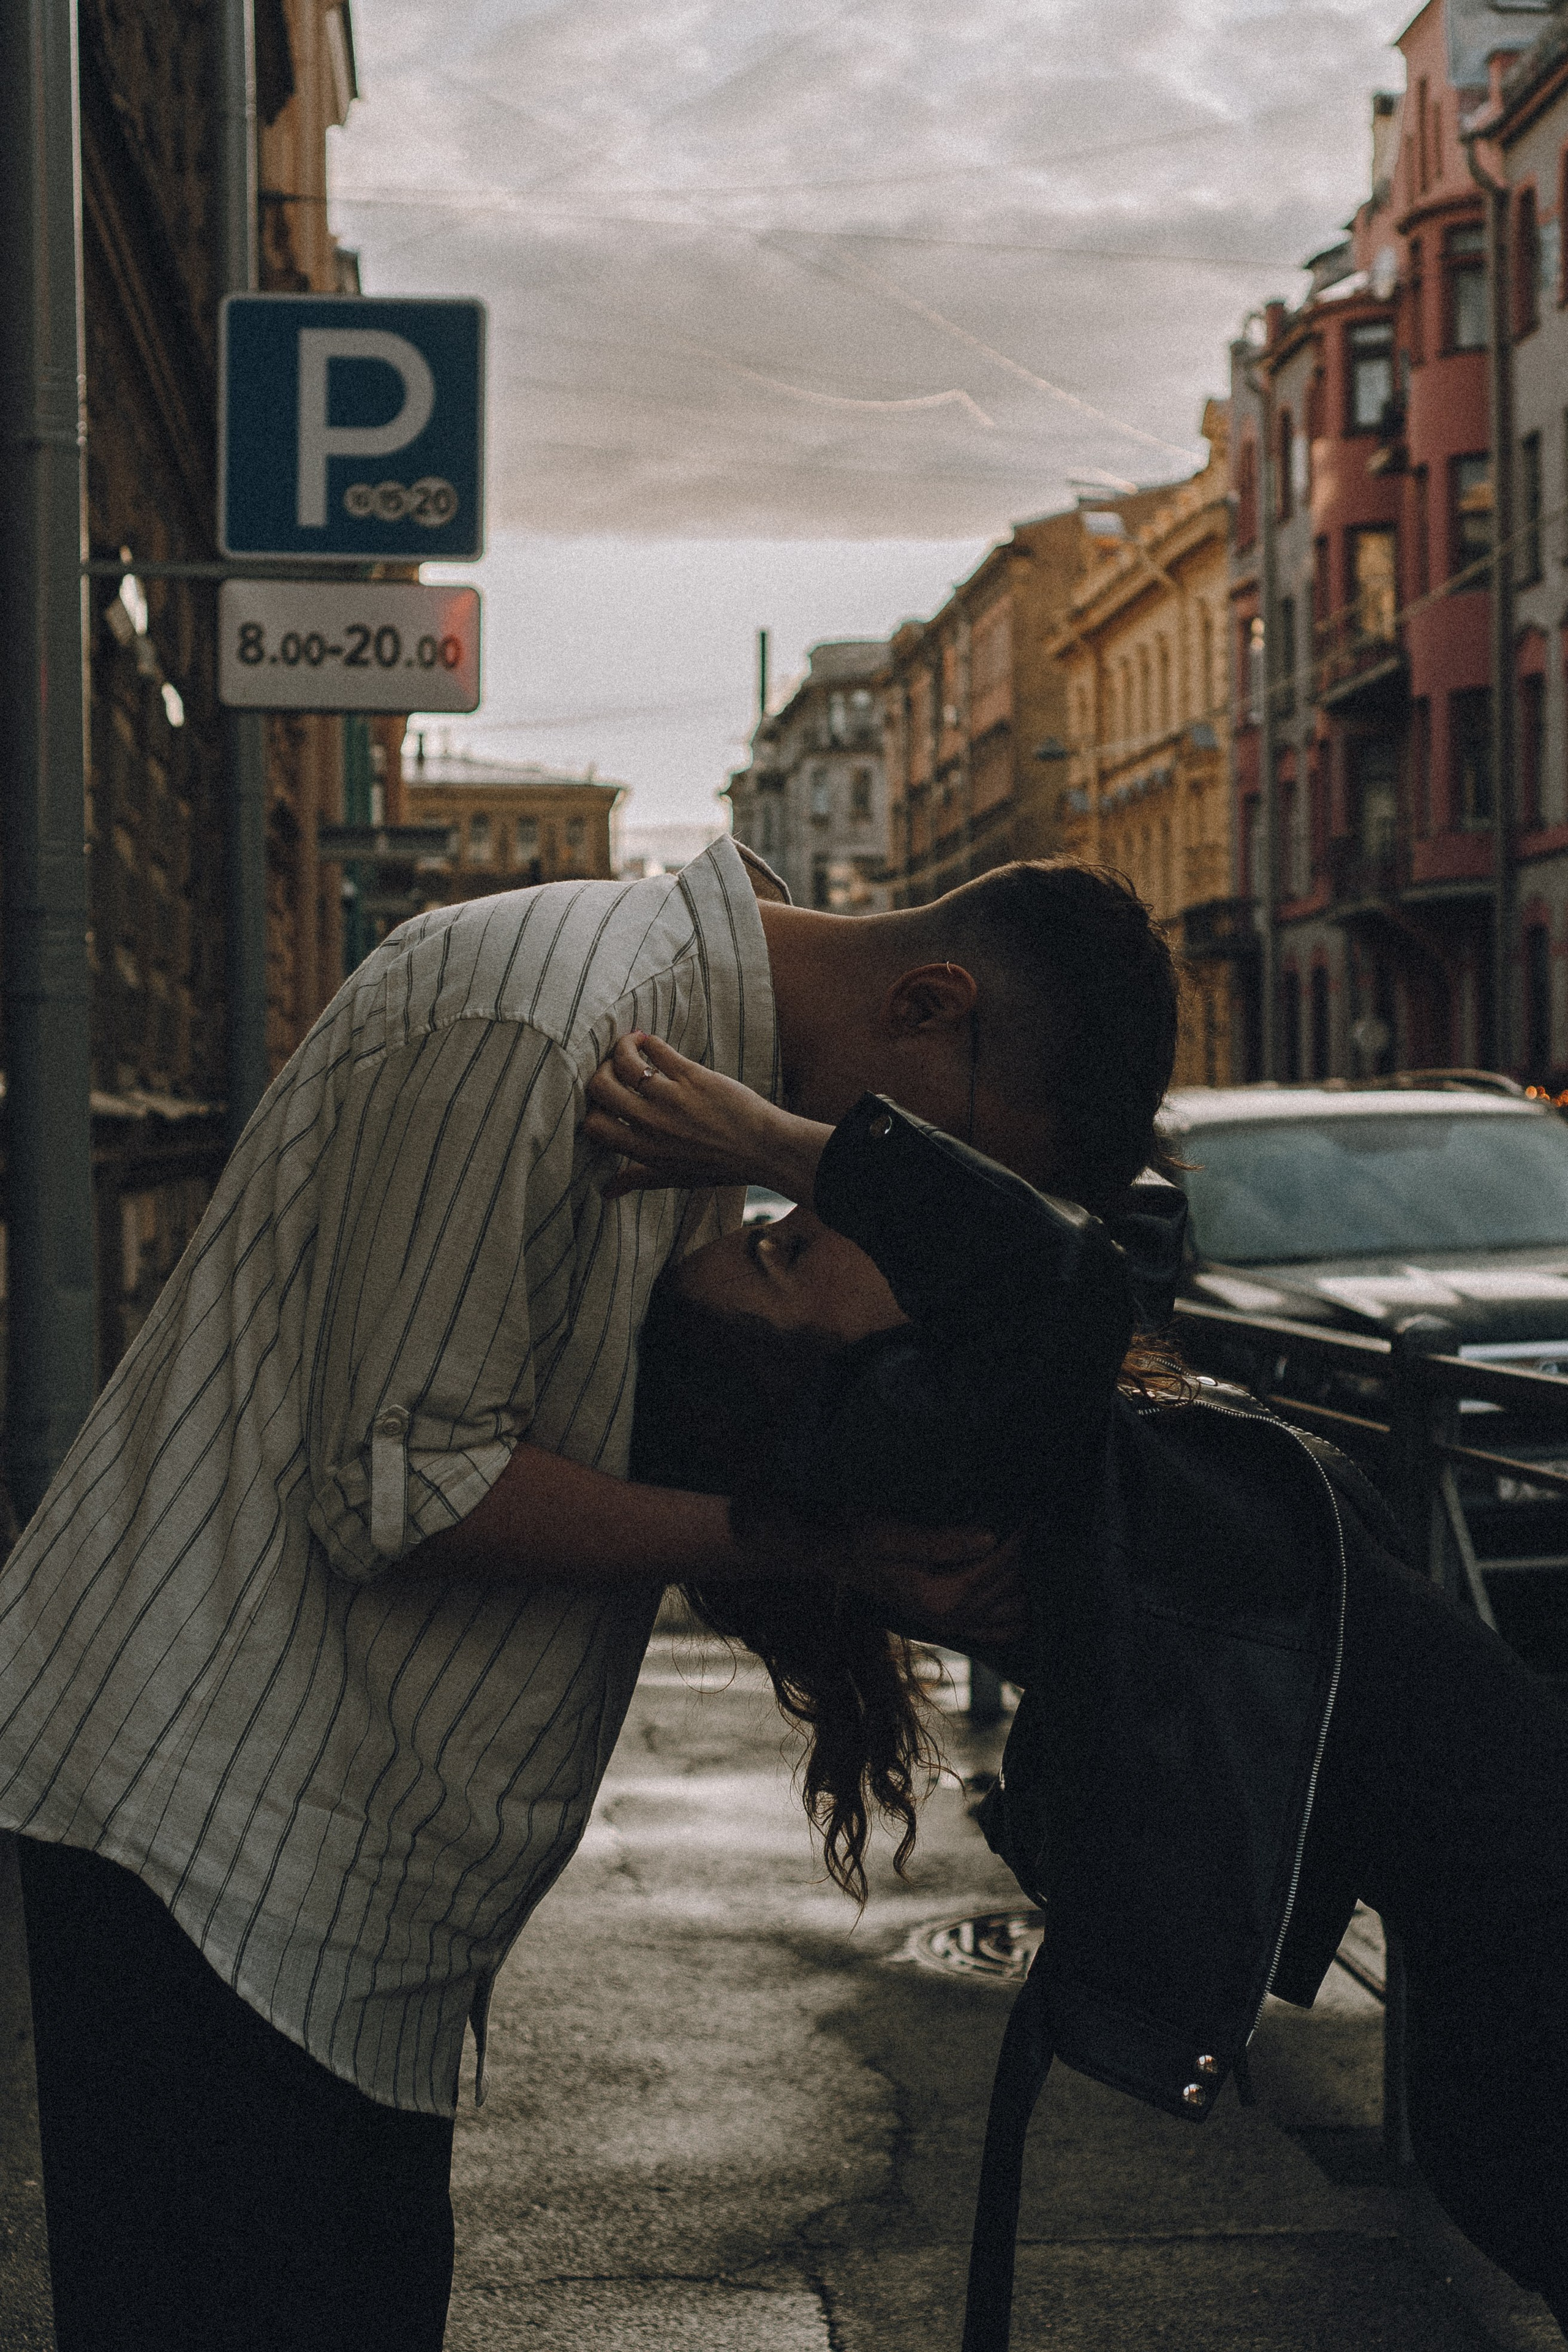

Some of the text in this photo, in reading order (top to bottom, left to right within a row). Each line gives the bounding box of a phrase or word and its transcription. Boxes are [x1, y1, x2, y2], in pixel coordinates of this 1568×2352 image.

[297, 328, 434, 527] P
[415, 486, 452, 516] 20
[238, 622, 462, 668] 8.00-20.00
